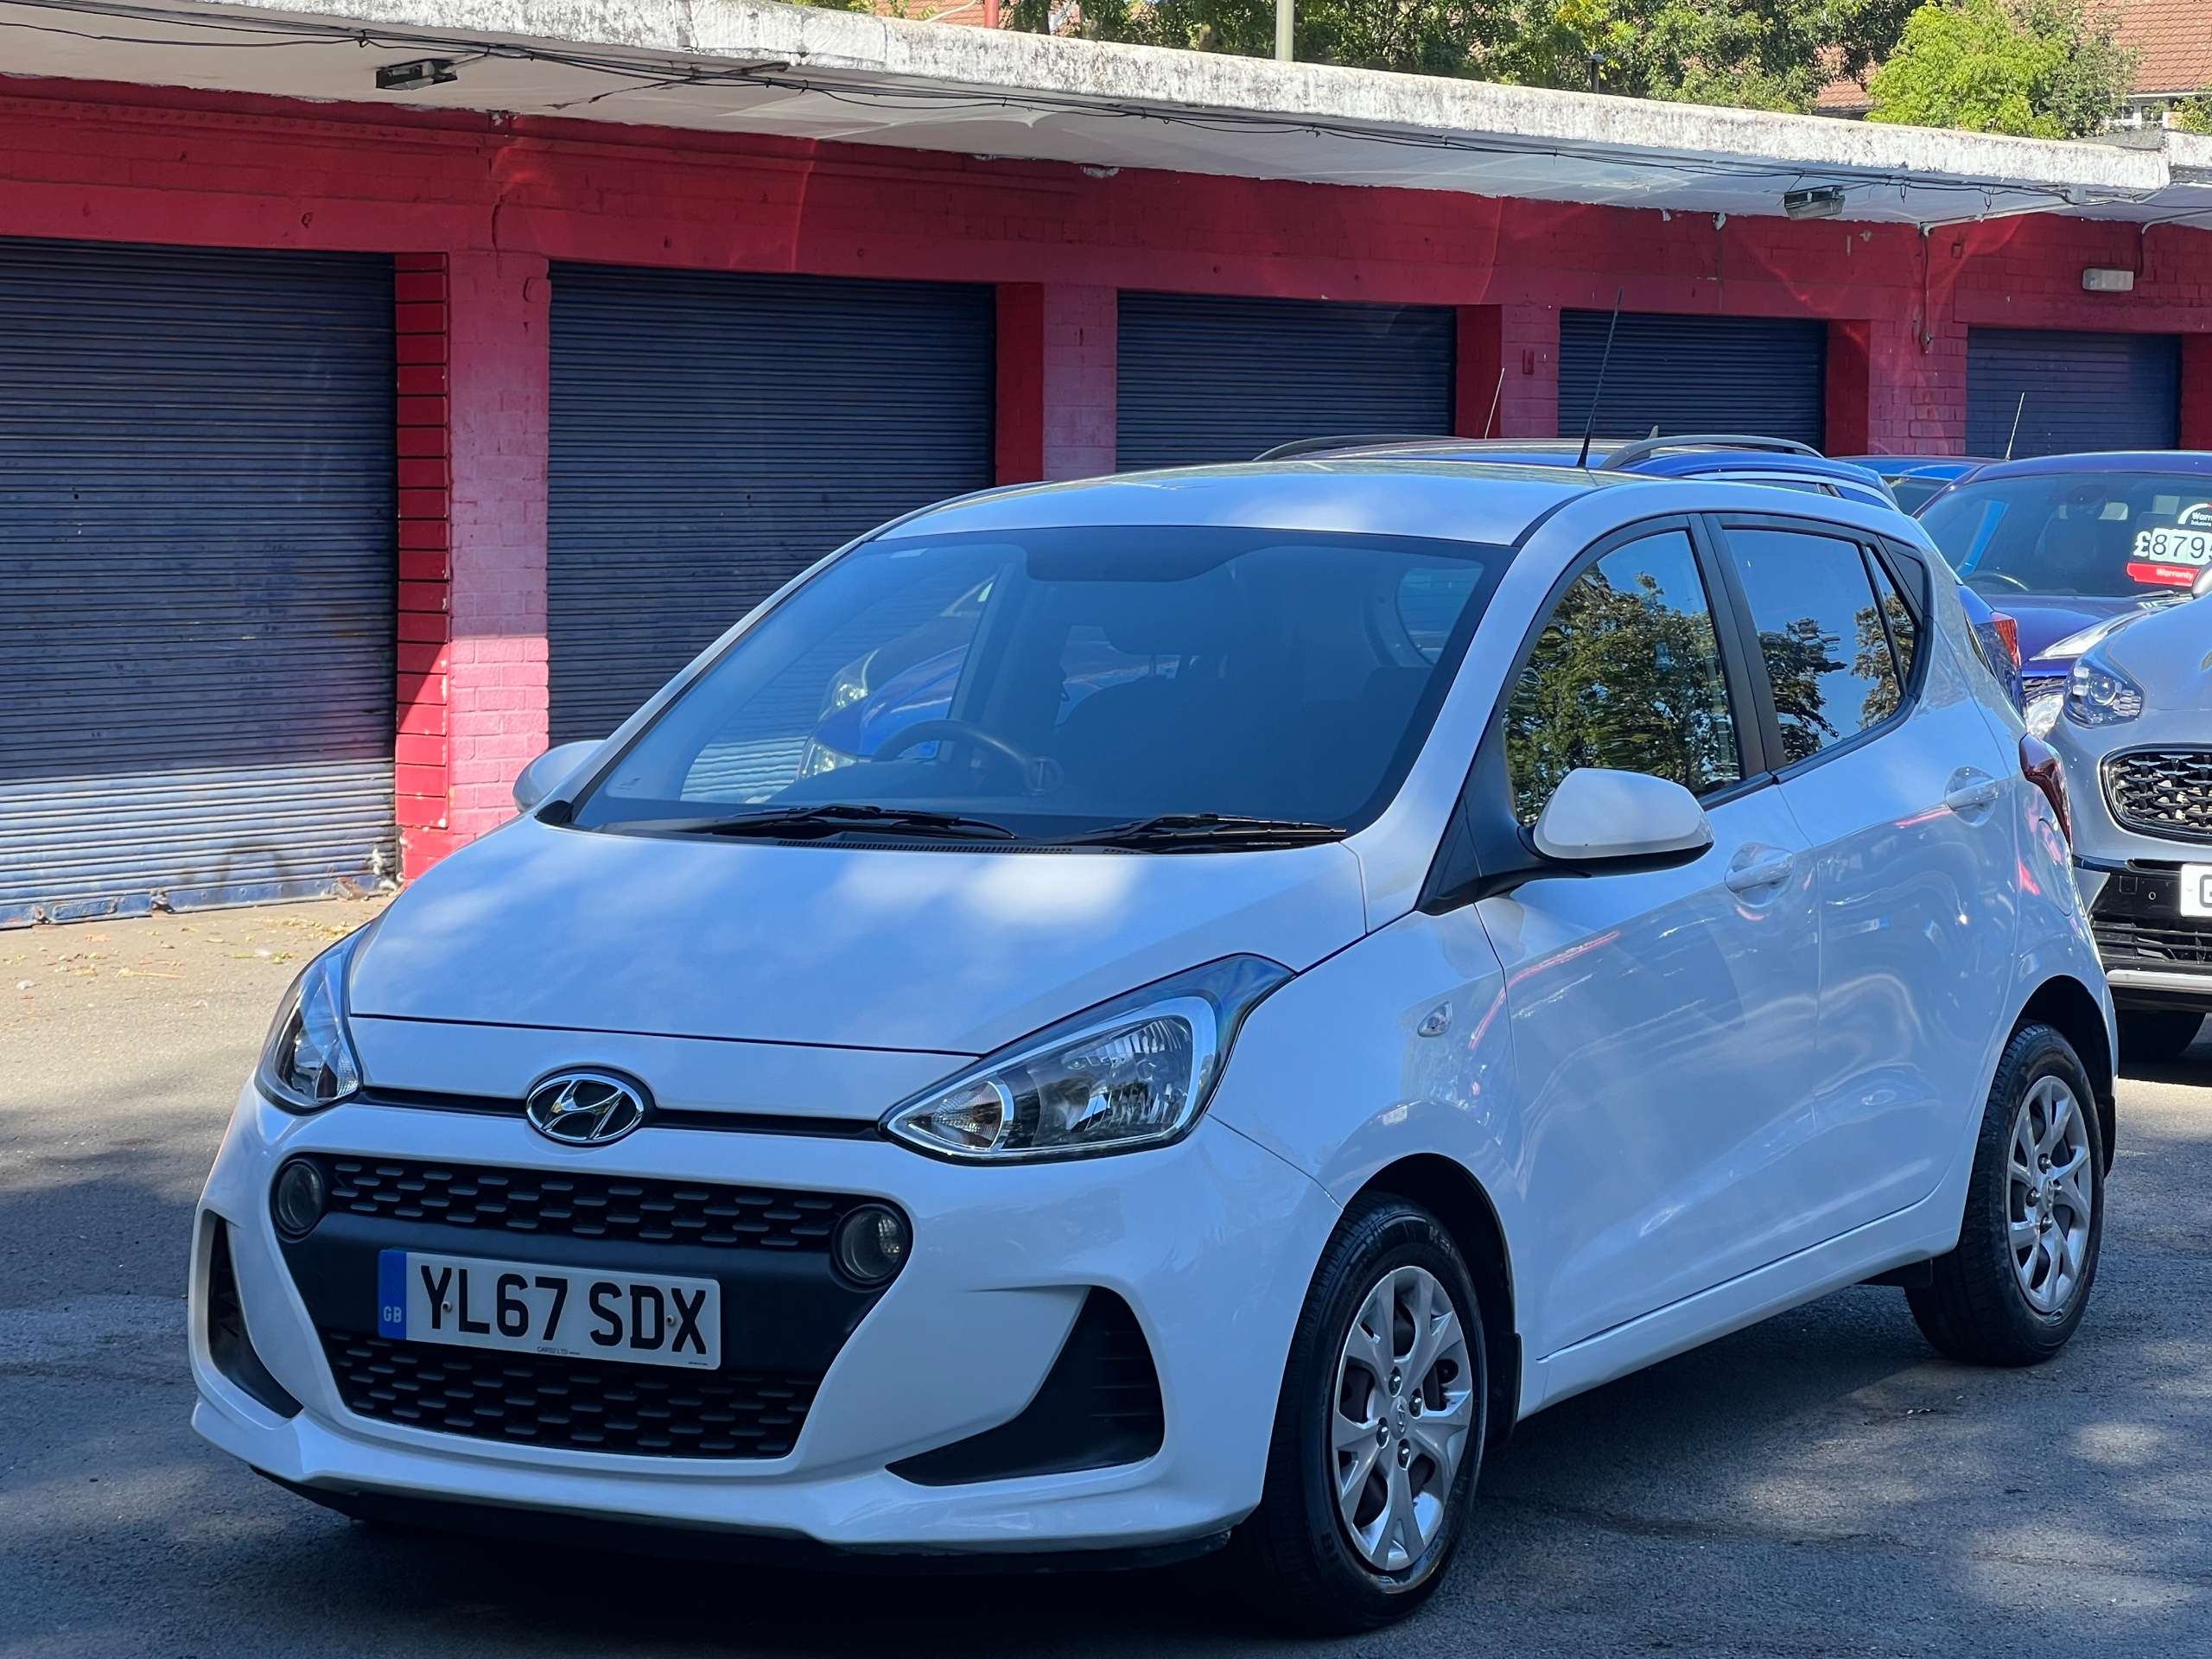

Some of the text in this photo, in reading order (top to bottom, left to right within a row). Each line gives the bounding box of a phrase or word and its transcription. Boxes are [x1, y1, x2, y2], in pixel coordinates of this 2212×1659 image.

[2133, 530, 2212, 560] £879
[2156, 568, 2194, 582] Warranty
[383, 1306, 402, 1323] GB
[420, 1265, 708, 1355] YL67 SDX
